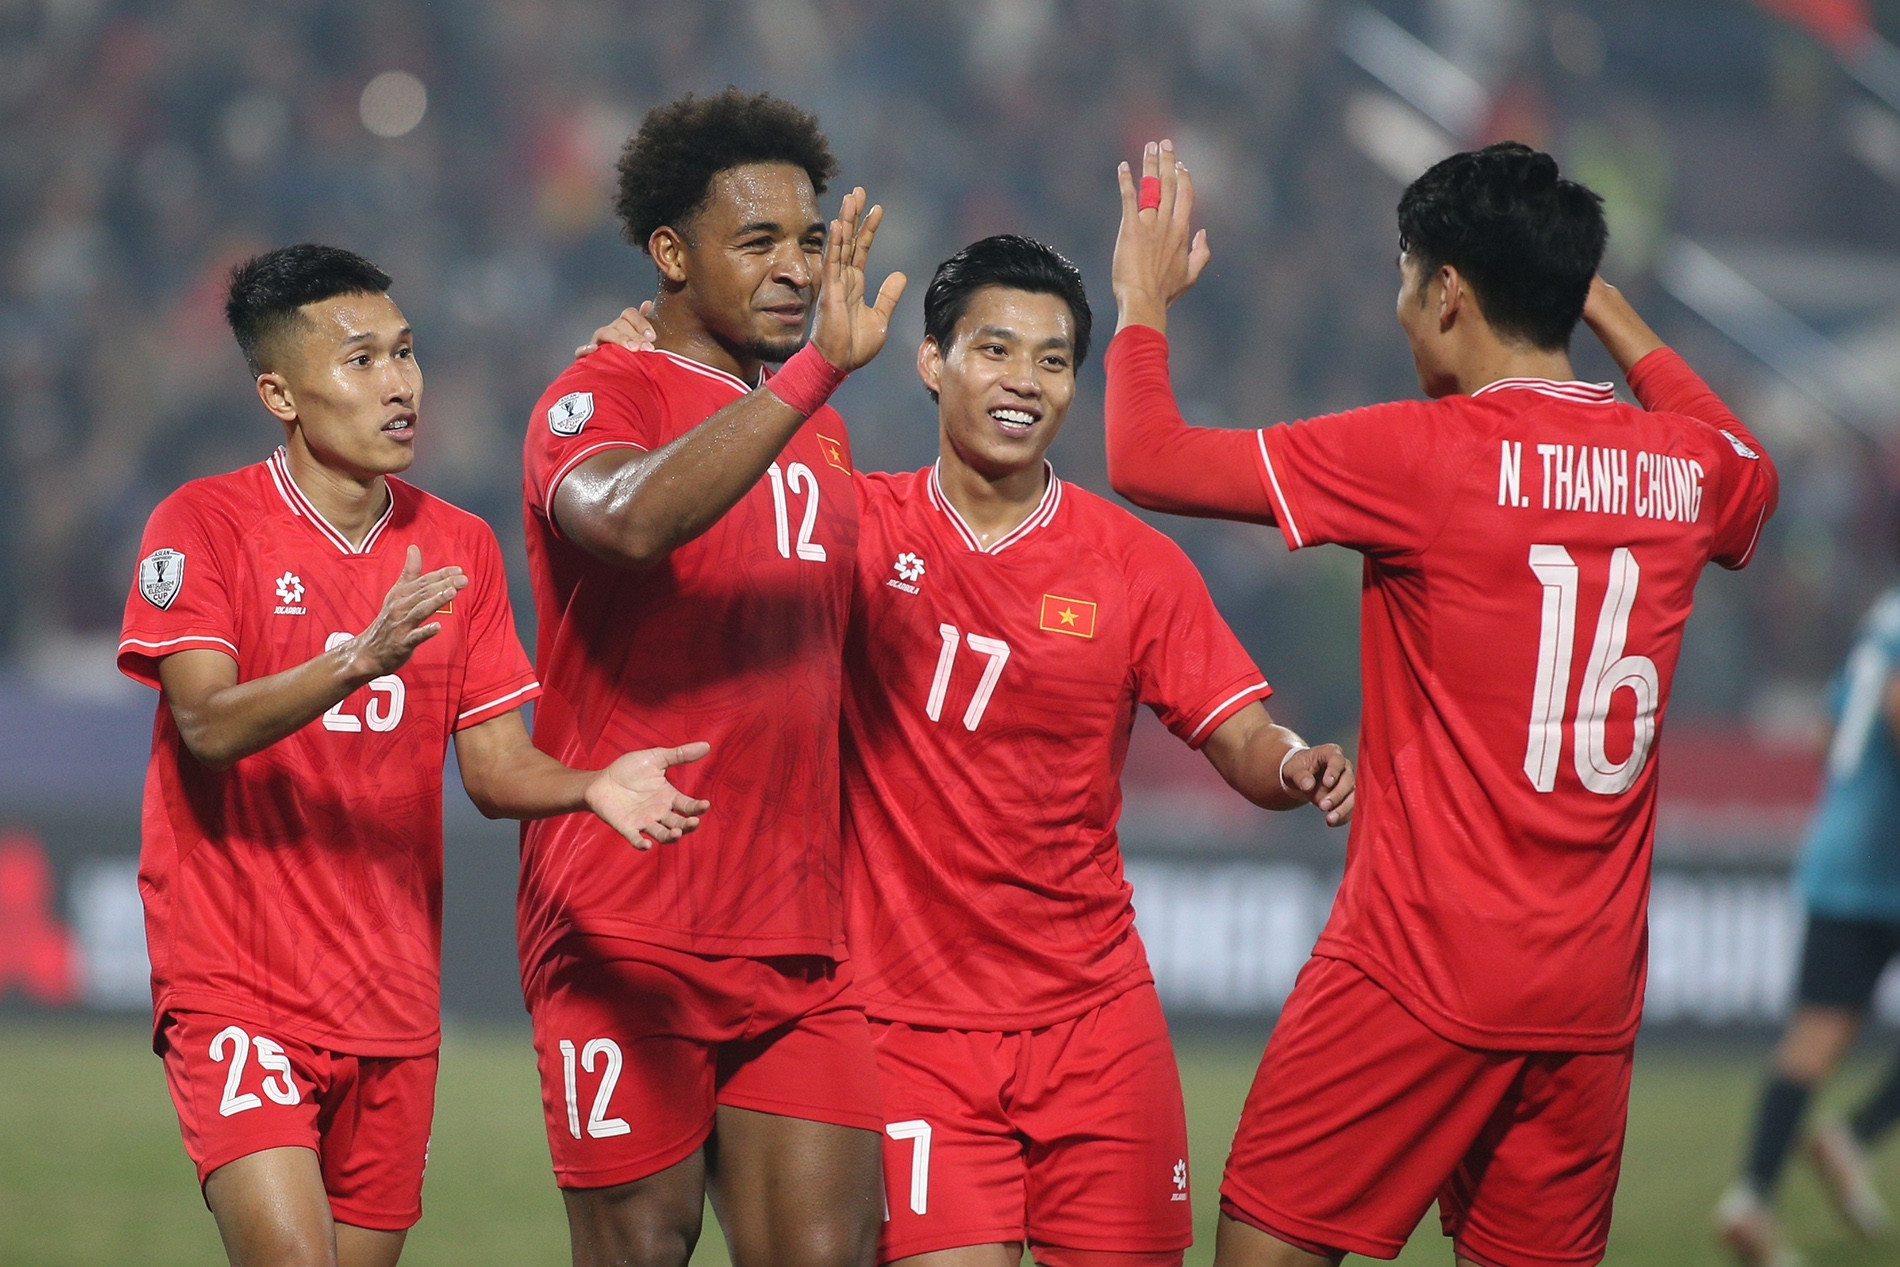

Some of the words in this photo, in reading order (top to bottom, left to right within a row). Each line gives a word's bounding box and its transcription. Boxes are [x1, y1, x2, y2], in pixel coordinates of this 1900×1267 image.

[768, 460, 827, 562] 12
[1497, 439, 1529, 508] N.
[1537, 443, 1628, 515] THANH
[1634, 450, 1705, 523] CHUNG
[152, 592, 169, 601] CUP
[925, 622, 1011, 732] 17
[1523, 543, 1659, 795] 16
[208, 1025, 301, 1117] 25
[559, 1037, 632, 1140] 12
